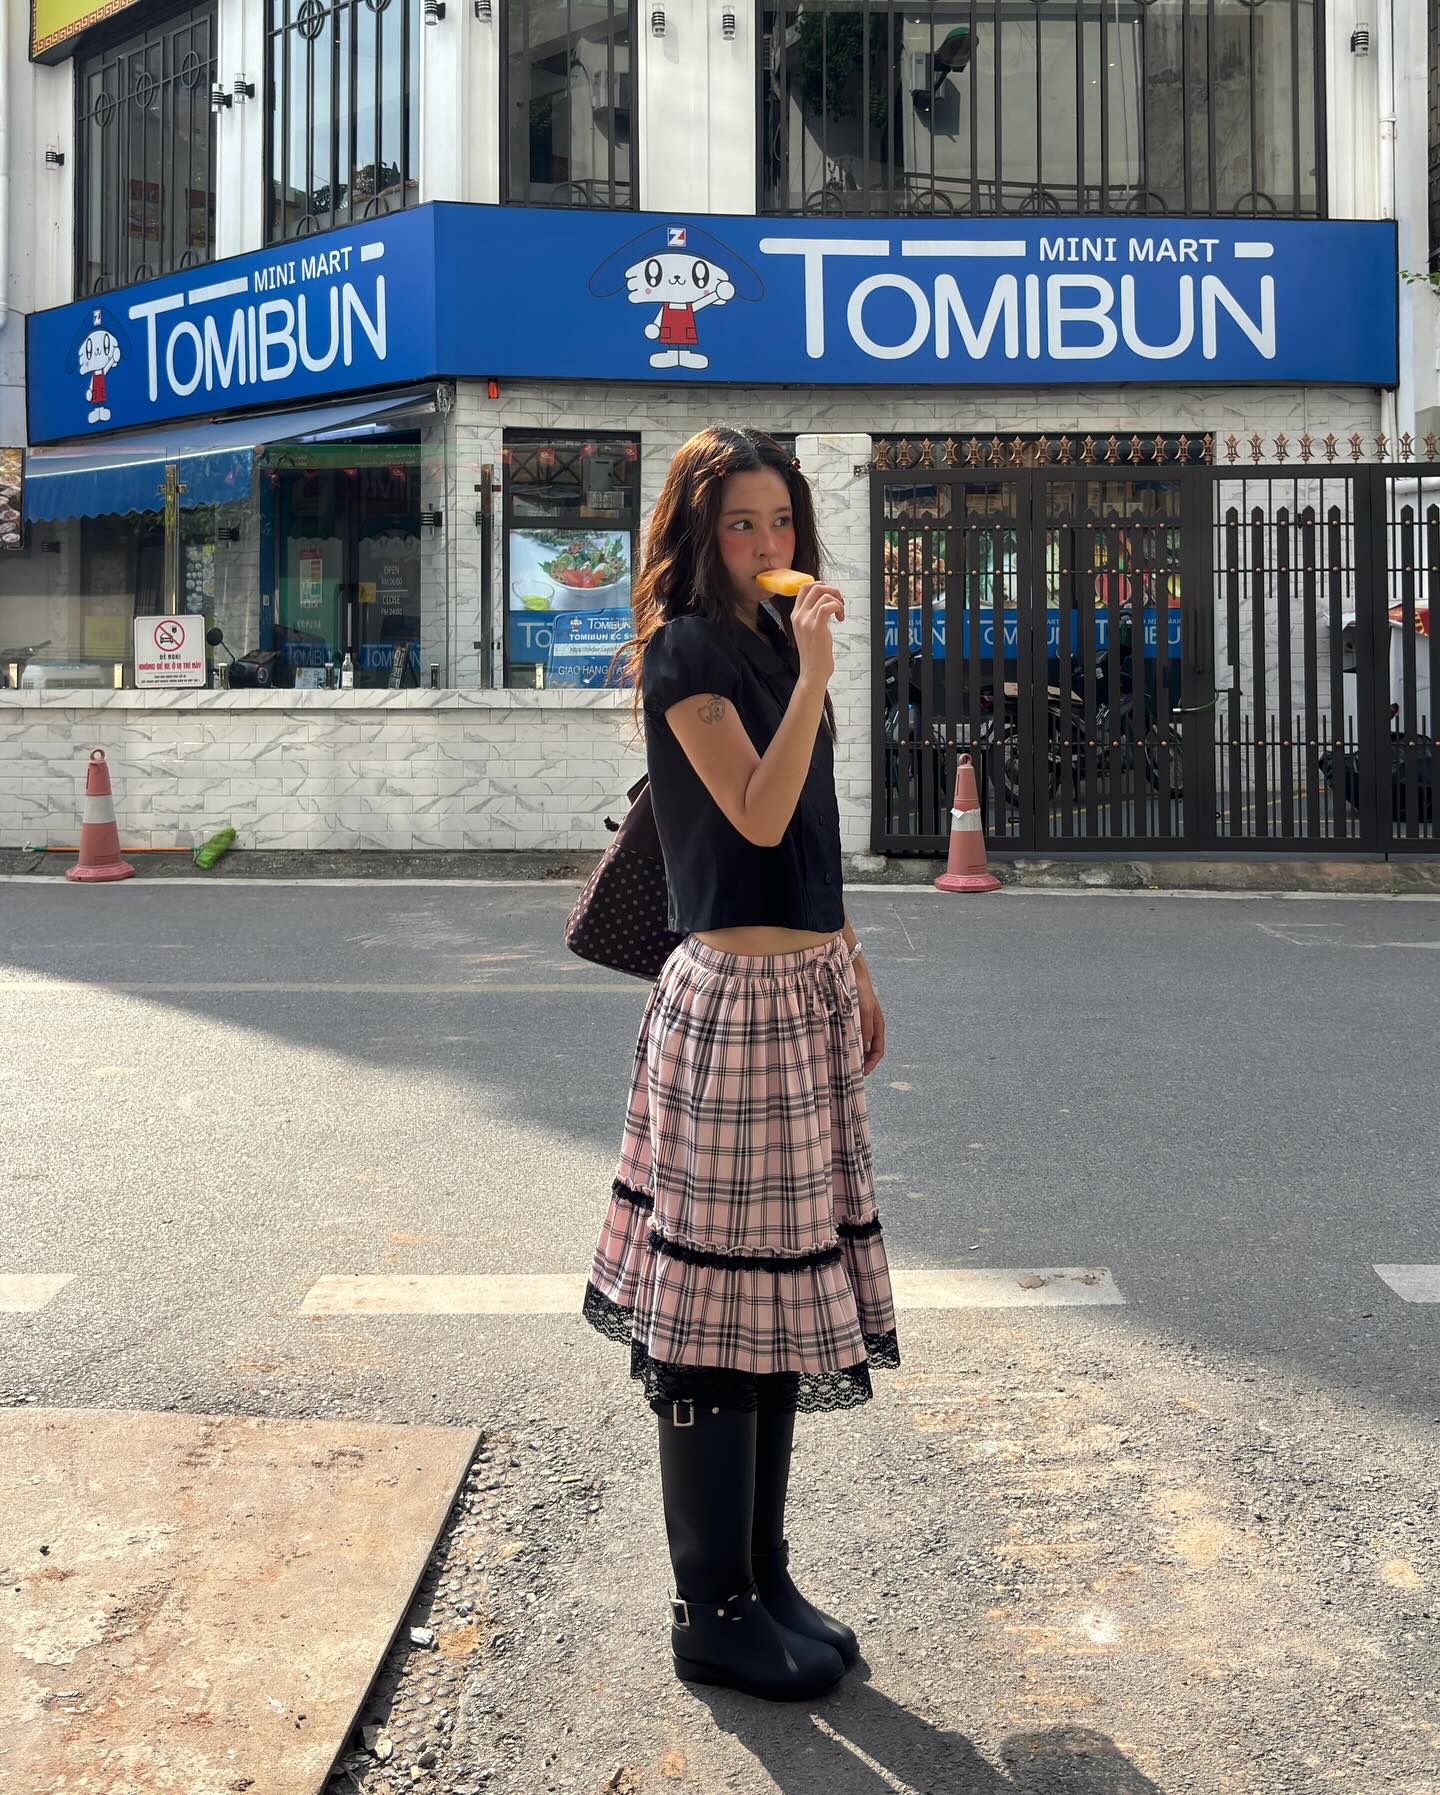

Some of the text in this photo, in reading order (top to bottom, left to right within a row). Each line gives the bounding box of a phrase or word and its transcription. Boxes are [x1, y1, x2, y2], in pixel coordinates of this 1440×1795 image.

[254, 246, 353, 293] MINI MART
[1039, 238, 1219, 263] MINI MART
[129, 274, 386, 402] TOMIBUN
[759, 239, 1276, 360] TOMIBUN
